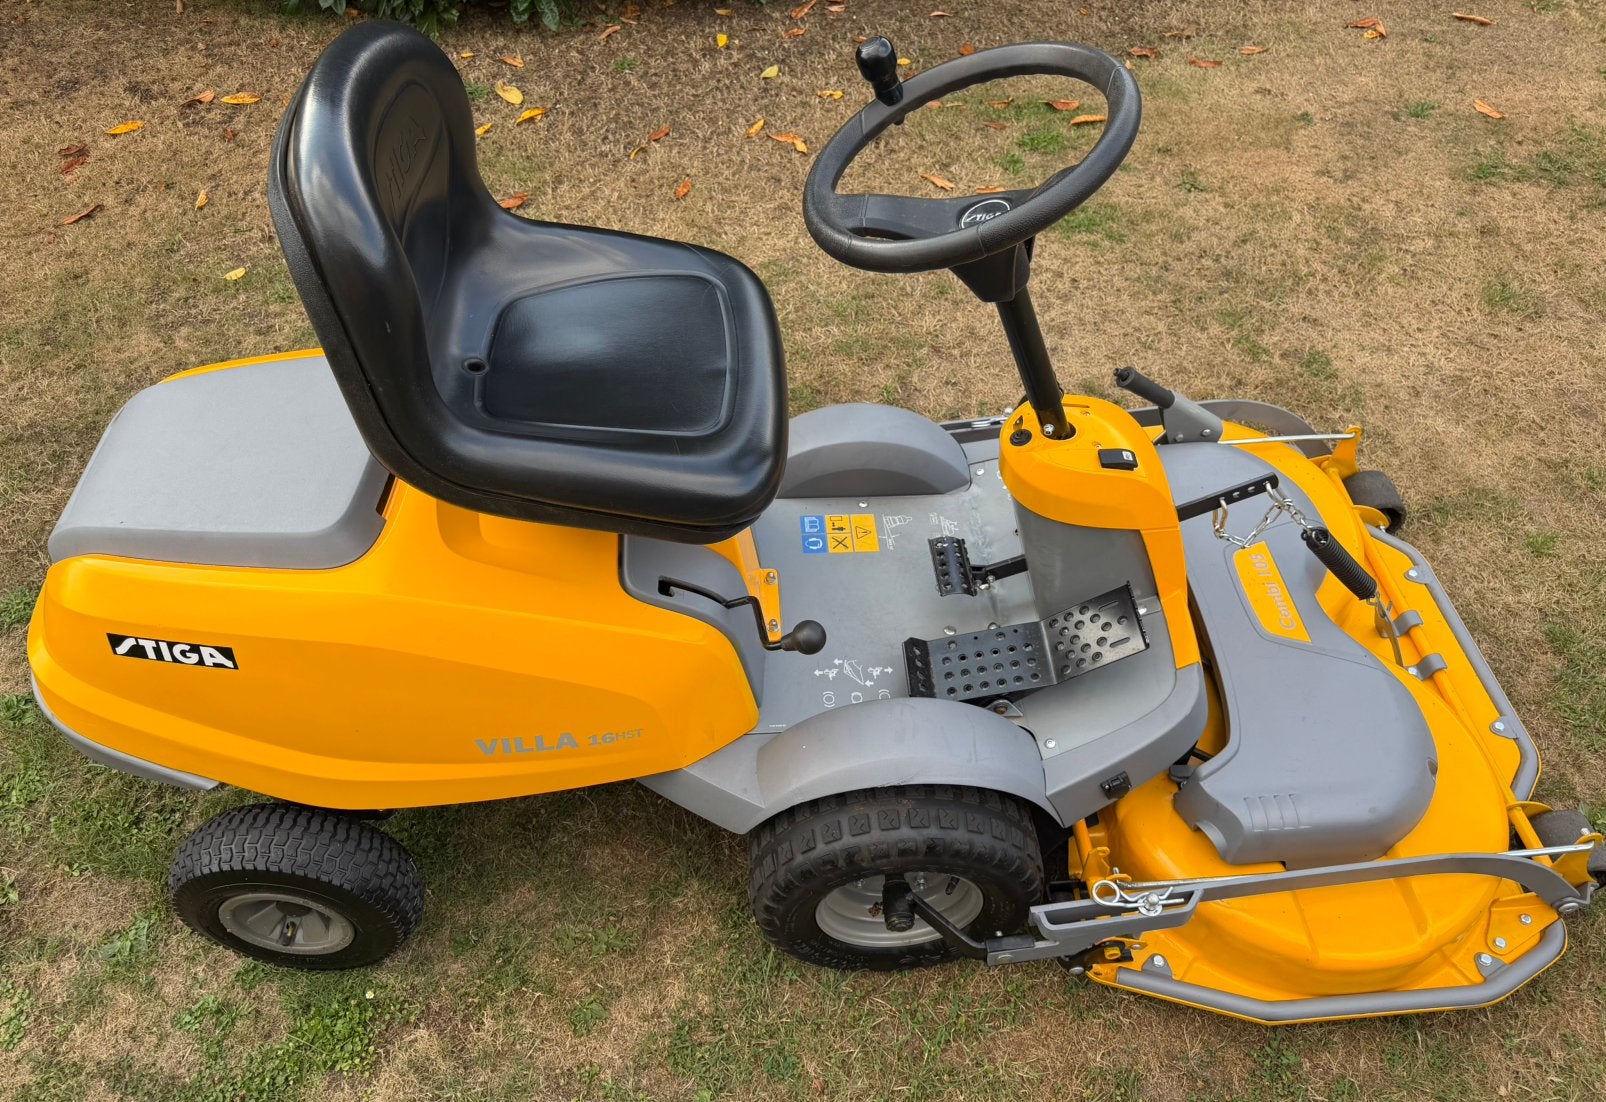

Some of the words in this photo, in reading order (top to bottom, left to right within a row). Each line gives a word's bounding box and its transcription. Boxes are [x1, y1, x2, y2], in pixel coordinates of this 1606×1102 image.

[1250, 553, 1272, 577] 105
[1264, 582, 1296, 630] Combi
[115, 637, 235, 669] STIGA
[475, 732, 579, 756] VILLA
